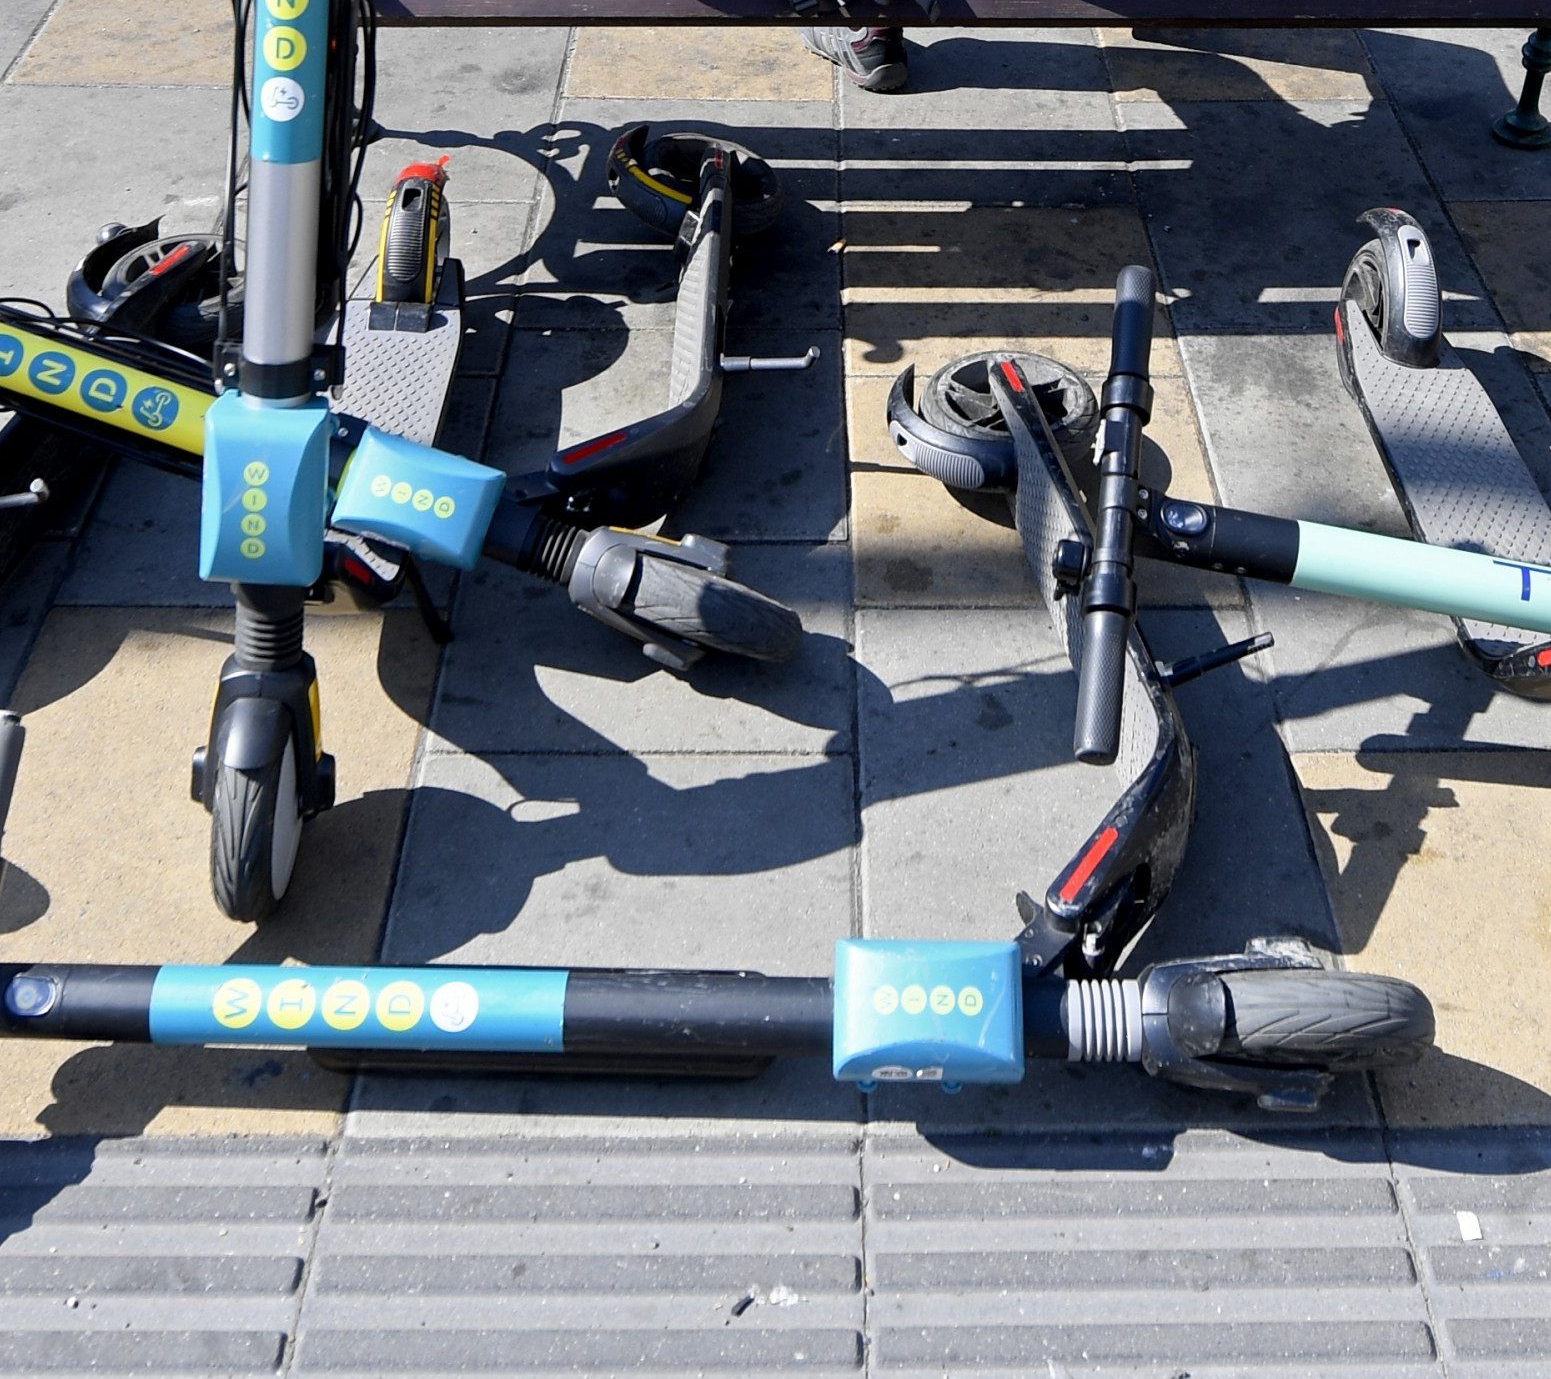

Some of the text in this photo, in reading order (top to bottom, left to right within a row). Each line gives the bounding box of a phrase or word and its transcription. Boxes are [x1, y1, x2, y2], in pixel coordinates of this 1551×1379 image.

[246, 468, 266, 554] WIND
[374, 479, 451, 513] WIND
[223, 986, 412, 1020] WIND
